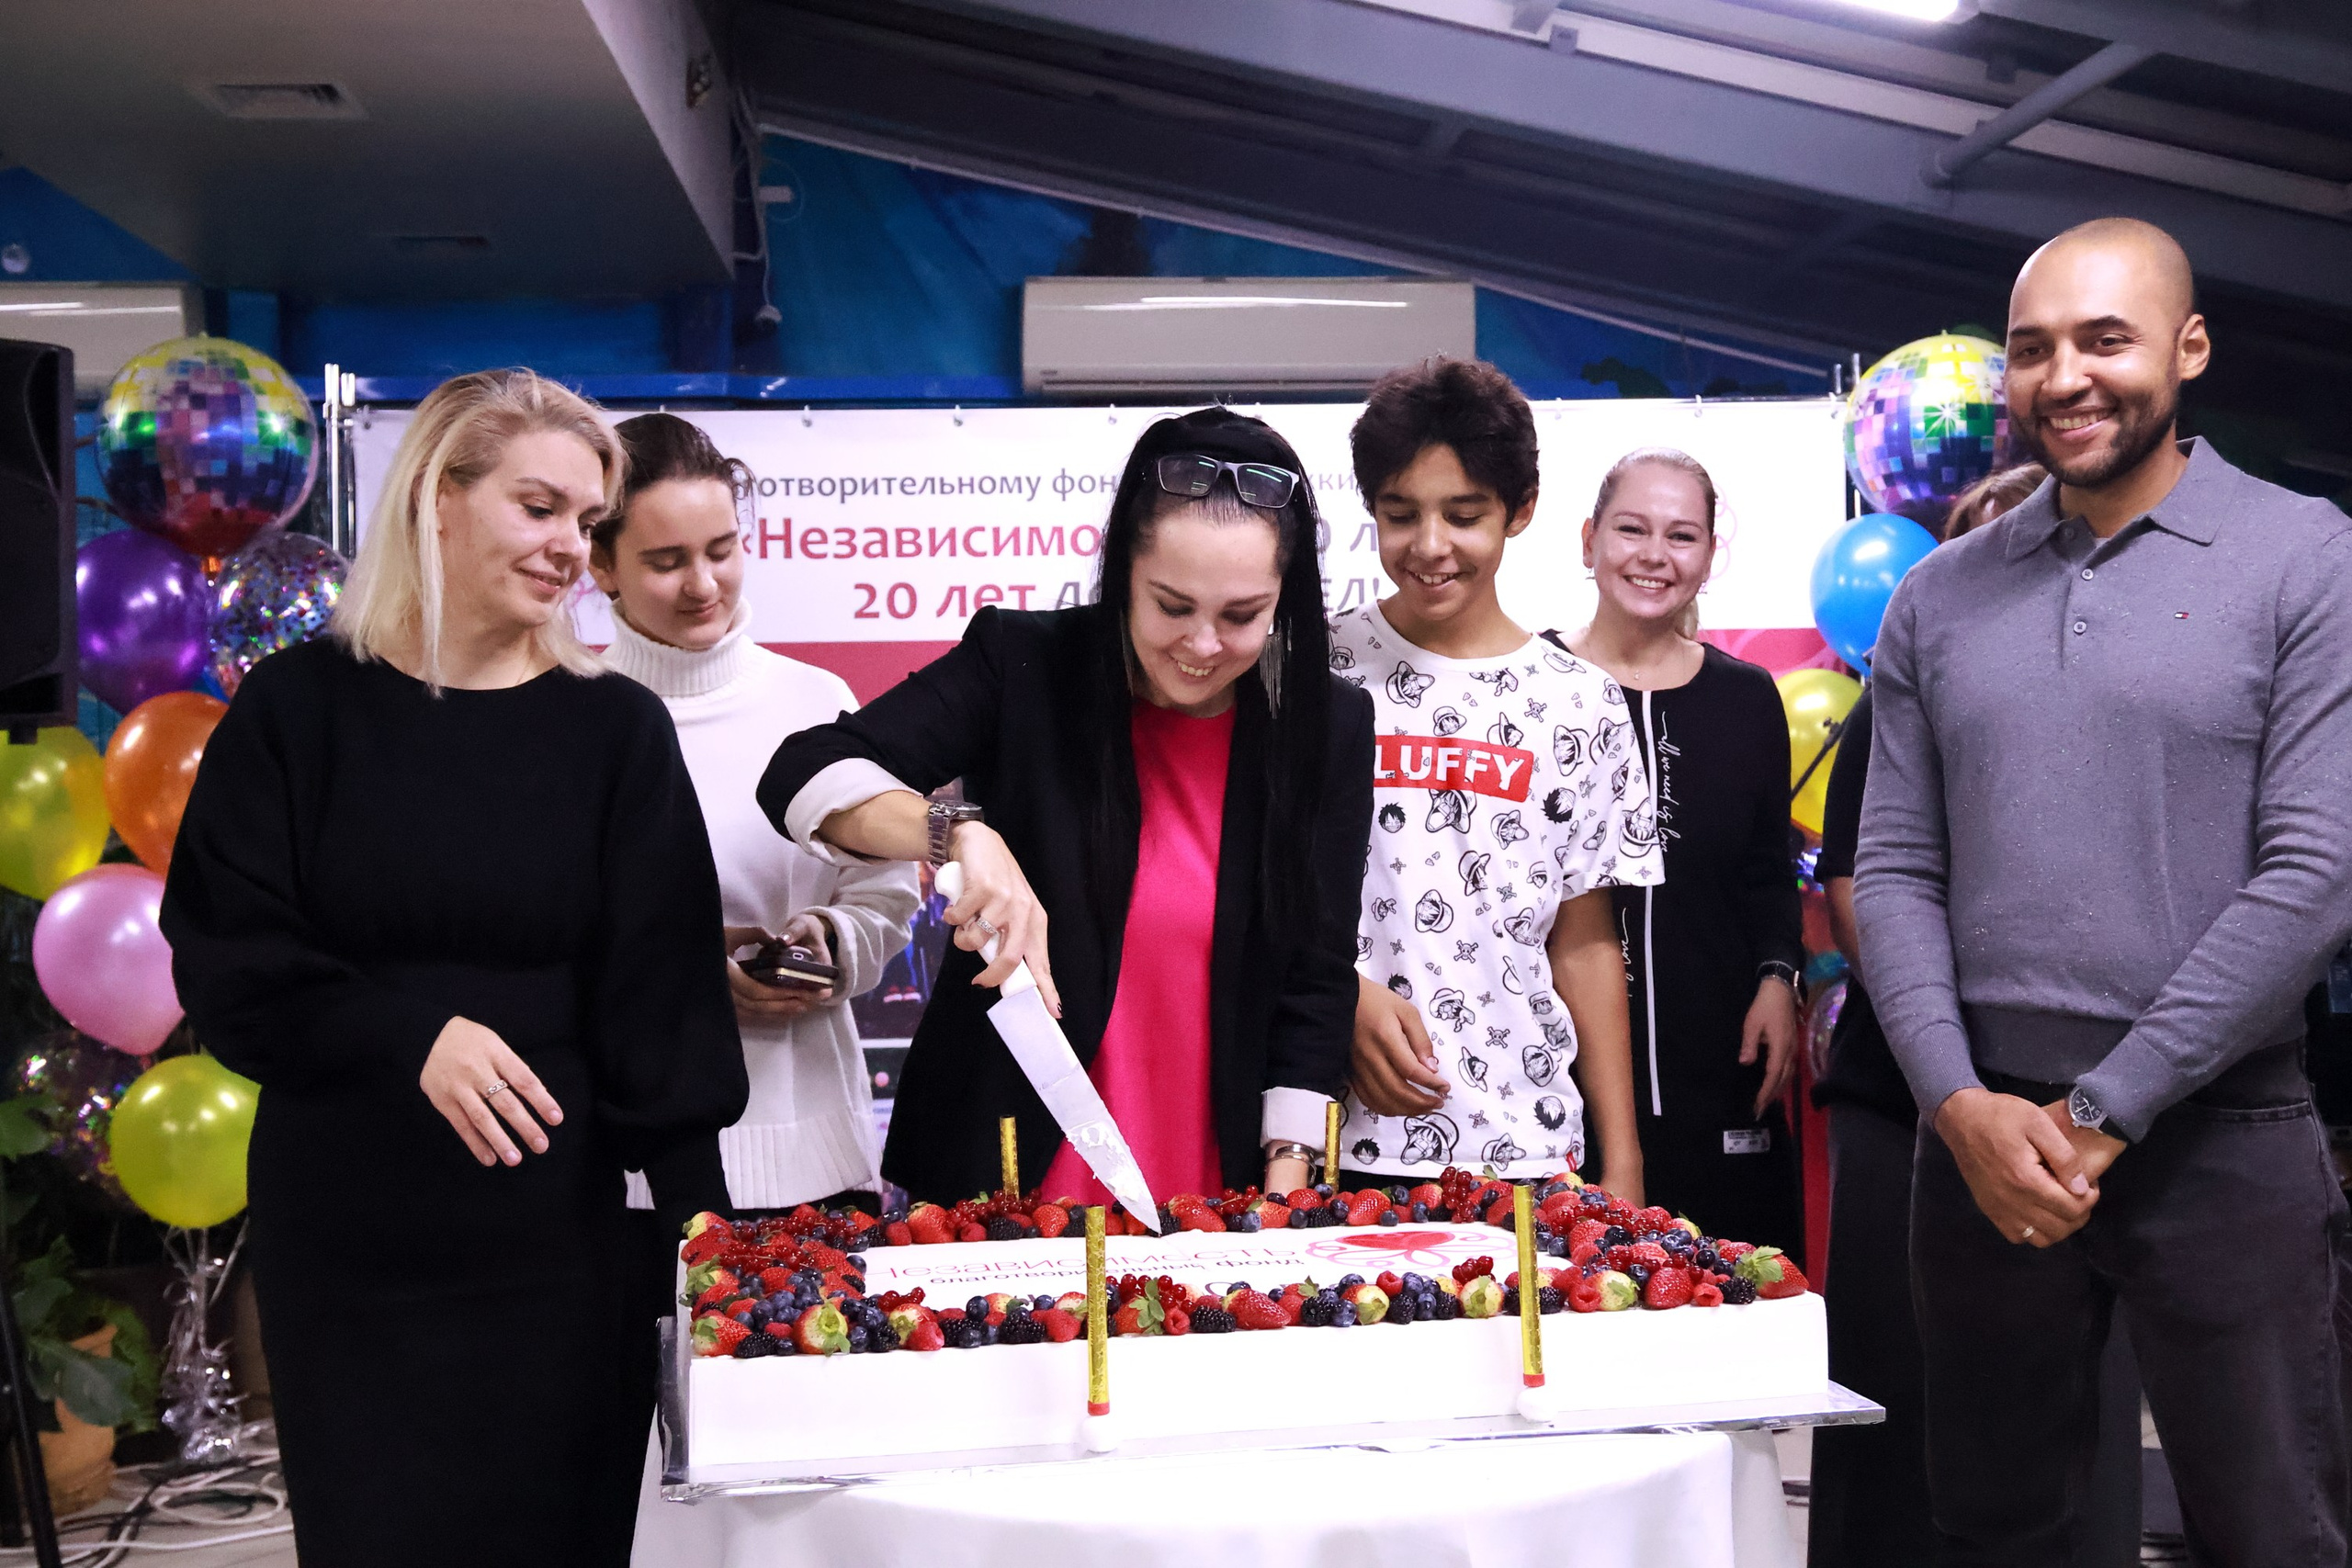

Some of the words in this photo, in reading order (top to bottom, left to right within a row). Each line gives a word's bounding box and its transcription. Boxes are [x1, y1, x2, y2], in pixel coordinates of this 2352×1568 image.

[759, 472, 1042, 503] отворительному
[1052, 468, 1118, 502] фон
[742, 517, 1102, 559] «Независимо
[854, 581, 918, 620] 20
[935, 583, 1036, 618] лет
[1374, 743, 1525, 792] LUFFY
[1658, 774, 1680, 806] need
[931, 1261, 1208, 1285] благотвориельный
[1216, 1258, 1305, 1269] фонд
